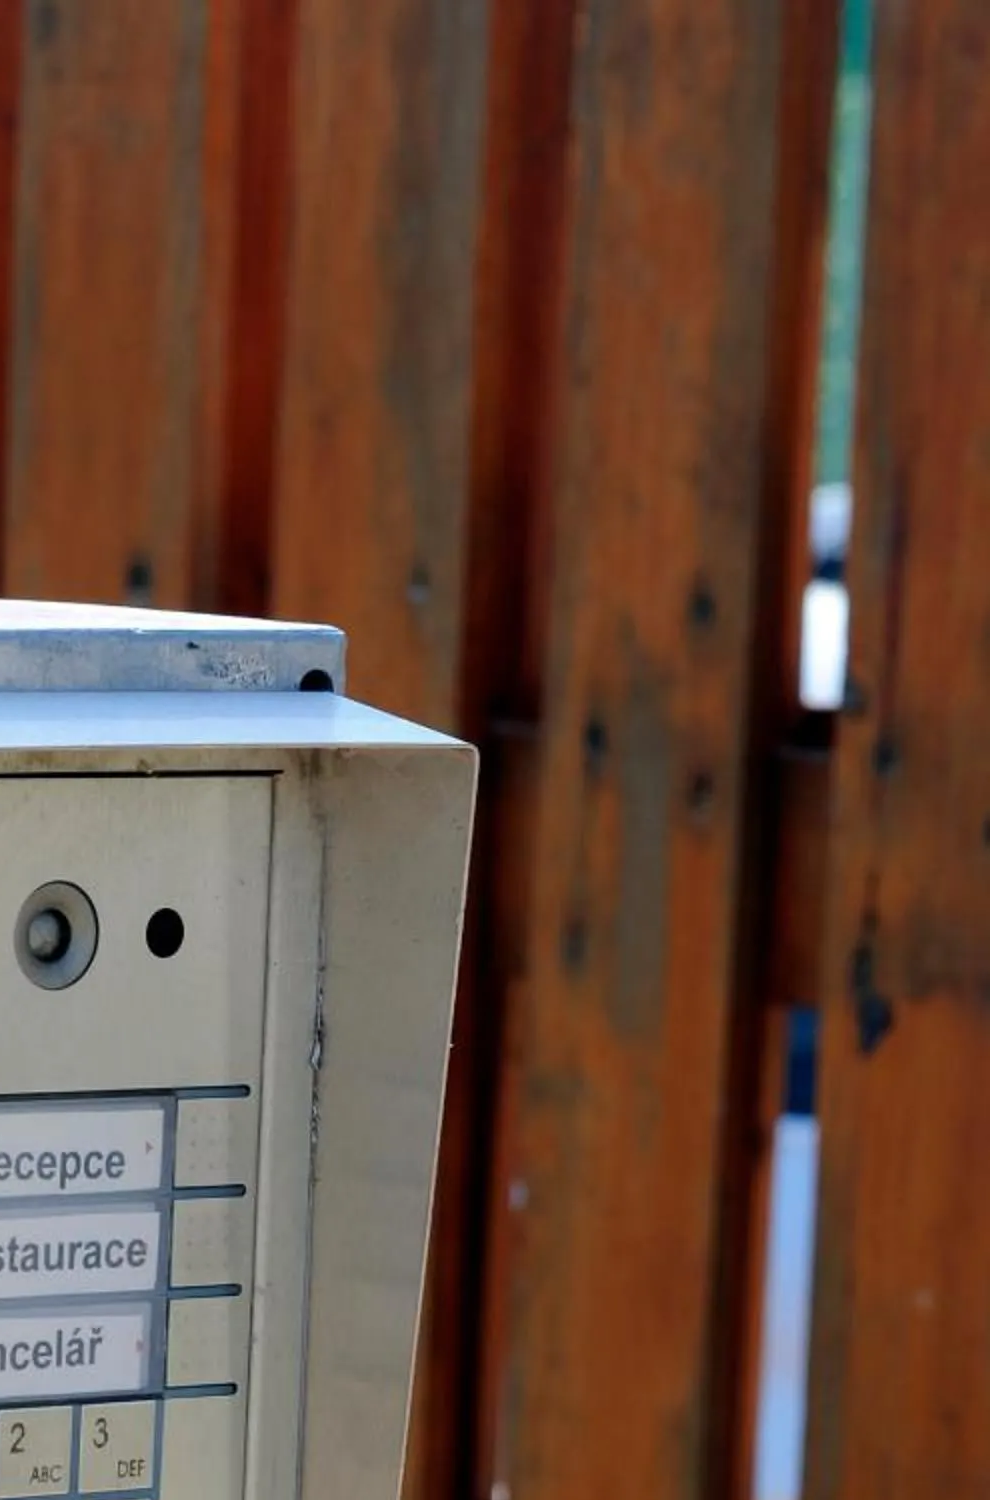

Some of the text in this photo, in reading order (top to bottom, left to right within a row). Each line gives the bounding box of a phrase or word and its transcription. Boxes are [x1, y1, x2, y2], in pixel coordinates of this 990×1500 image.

[10, 1422, 26, 1453] 2
[93, 1417, 109, 1448] 3
[29, 1464, 62, 1485] ABC
[116, 1459, 146, 1478] DEF
